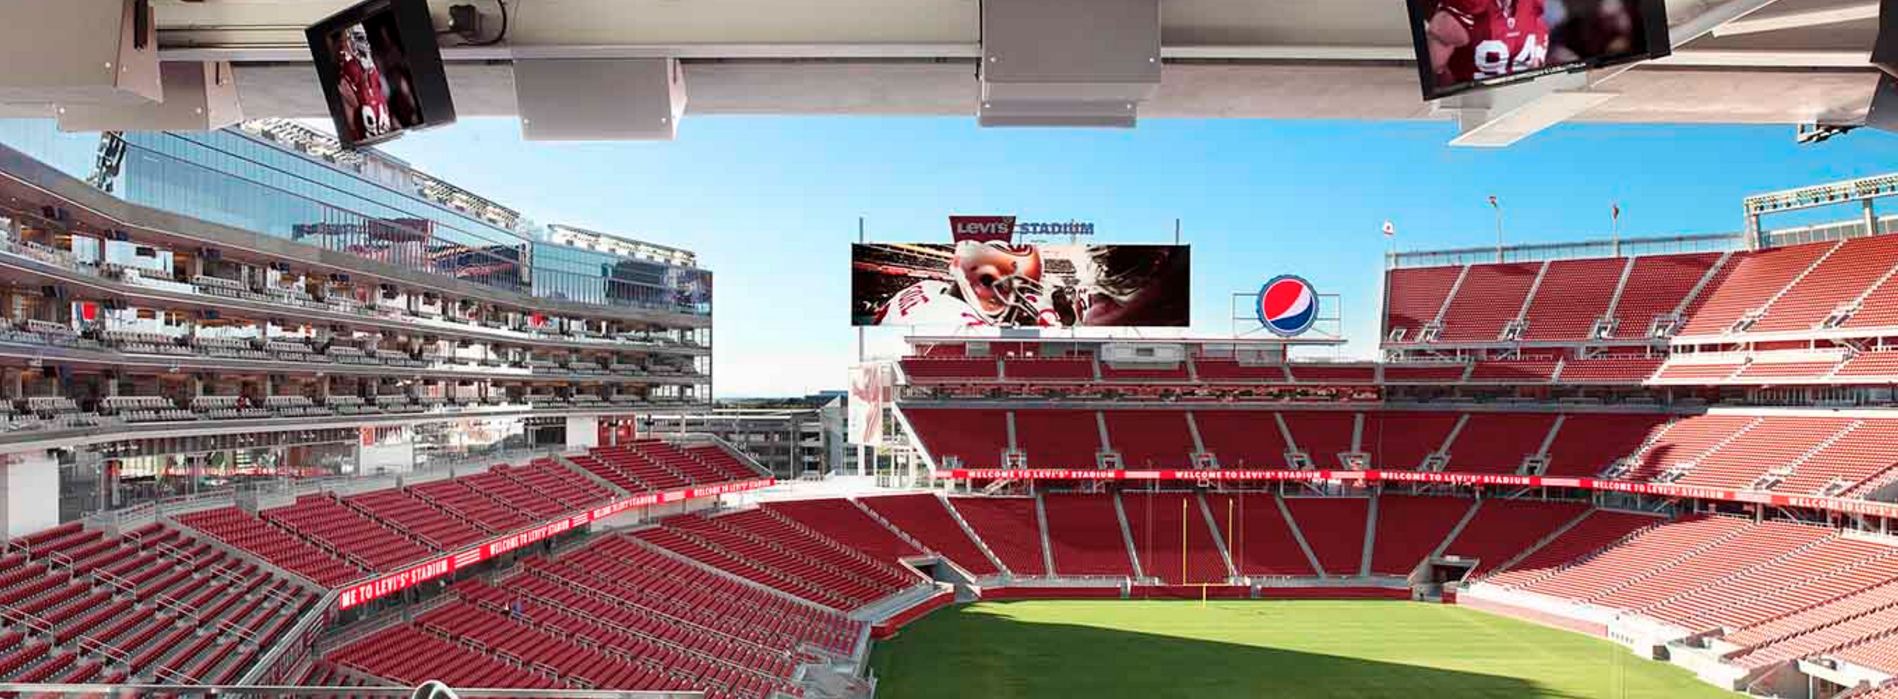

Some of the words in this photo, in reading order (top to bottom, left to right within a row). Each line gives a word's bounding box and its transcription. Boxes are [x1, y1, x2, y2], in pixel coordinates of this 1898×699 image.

[1474, 34, 1548, 76] 94
[1019, 222, 1094, 235] STADIUM
[968, 471, 1015, 479] WELCOME
[1018, 471, 1031, 479] TO
[1071, 471, 1115, 479] STADIUM
[1175, 471, 1221, 479] WELCOME
[1225, 471, 1237, 479] TO
[1380, 472, 1426, 481] WELCOME
[1429, 473, 1442, 481] TO
[1483, 476, 1530, 484] STADIUM
[1592, 480, 1632, 491] WELCOME
[1634, 483, 1645, 492] TO
[1682, 488, 1724, 499] STADIUM
[360, 584, 373, 601] TO
[411, 559, 447, 584] STADIUM
